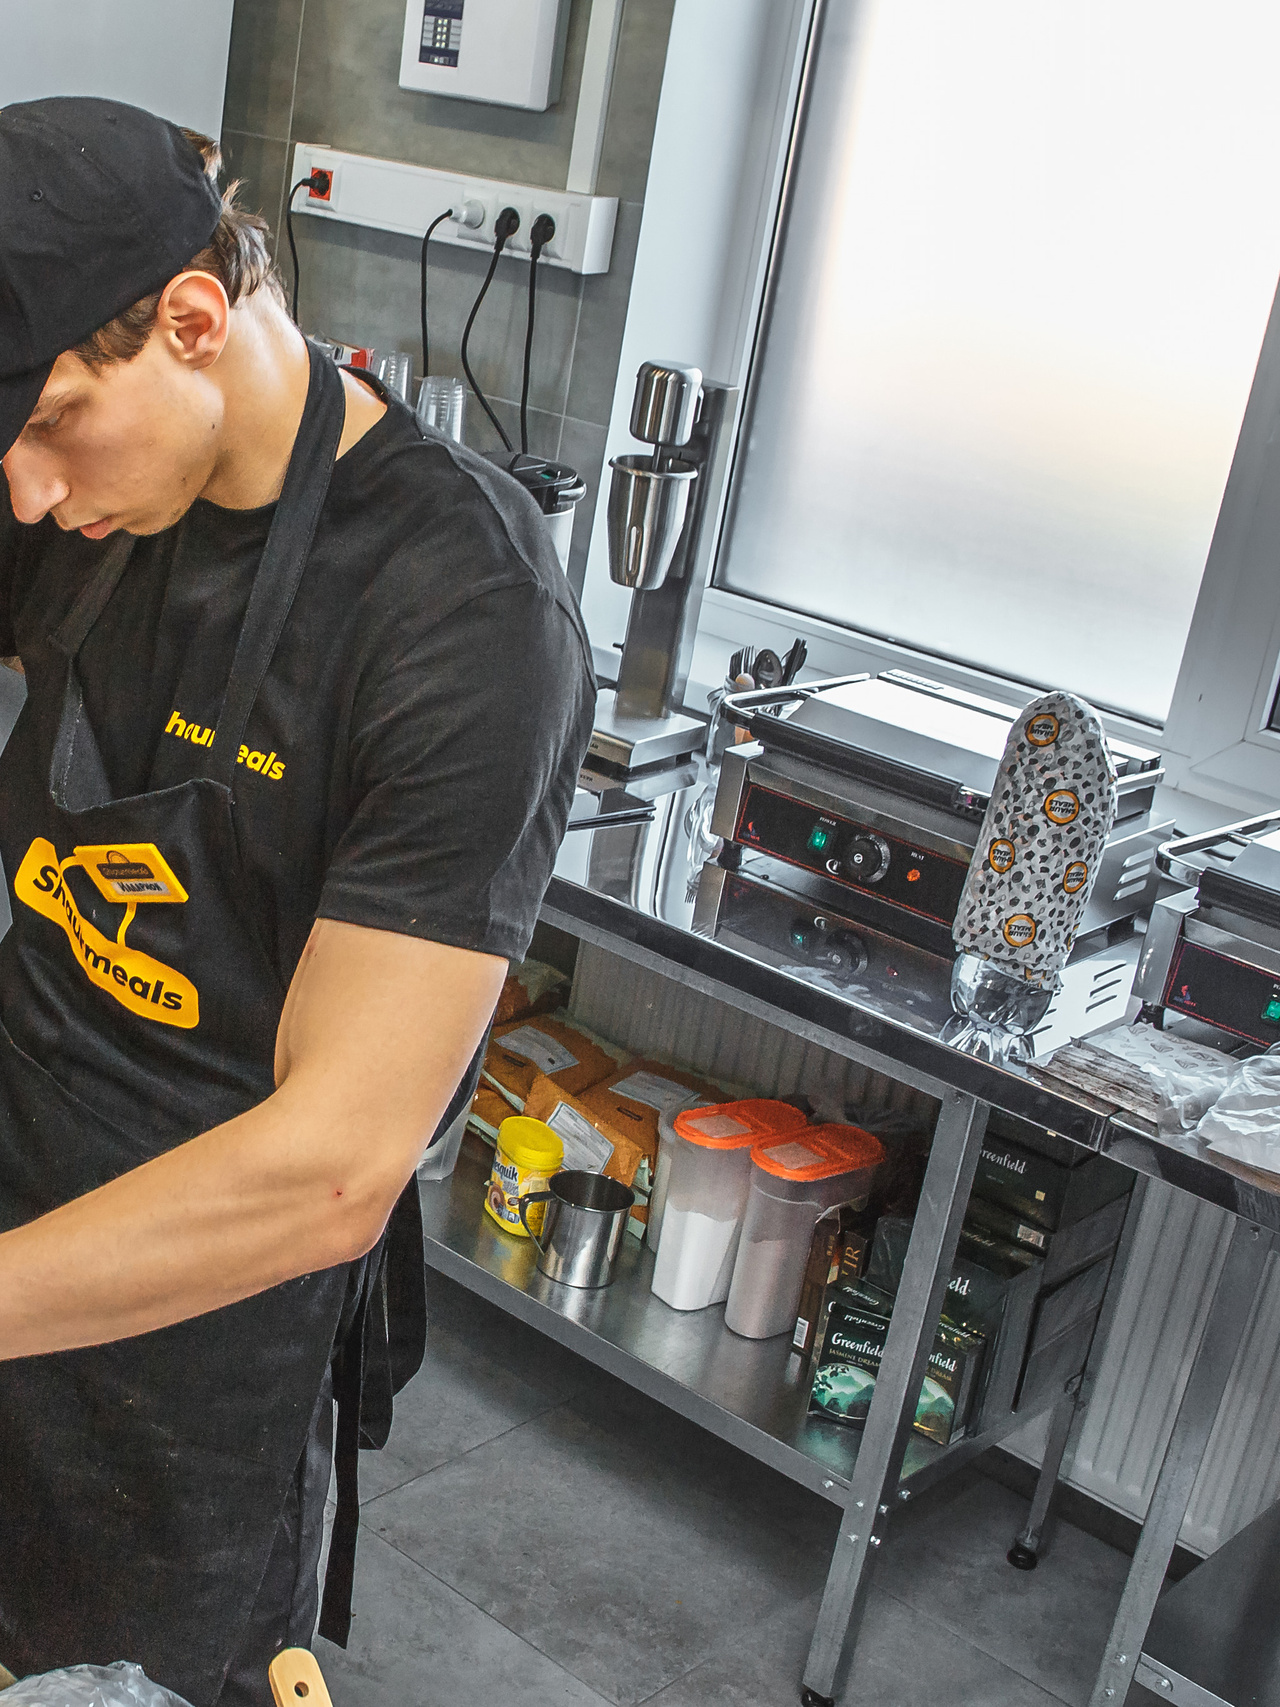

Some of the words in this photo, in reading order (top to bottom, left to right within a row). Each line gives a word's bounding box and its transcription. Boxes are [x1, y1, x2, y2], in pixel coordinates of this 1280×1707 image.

[32, 864, 183, 1011] Shaurmeals
[493, 1160, 518, 1182] esquik
[980, 1149, 1027, 1175] reenfield
[947, 1276, 970, 1296] eld
[844, 1314, 885, 1331] Greenfield
